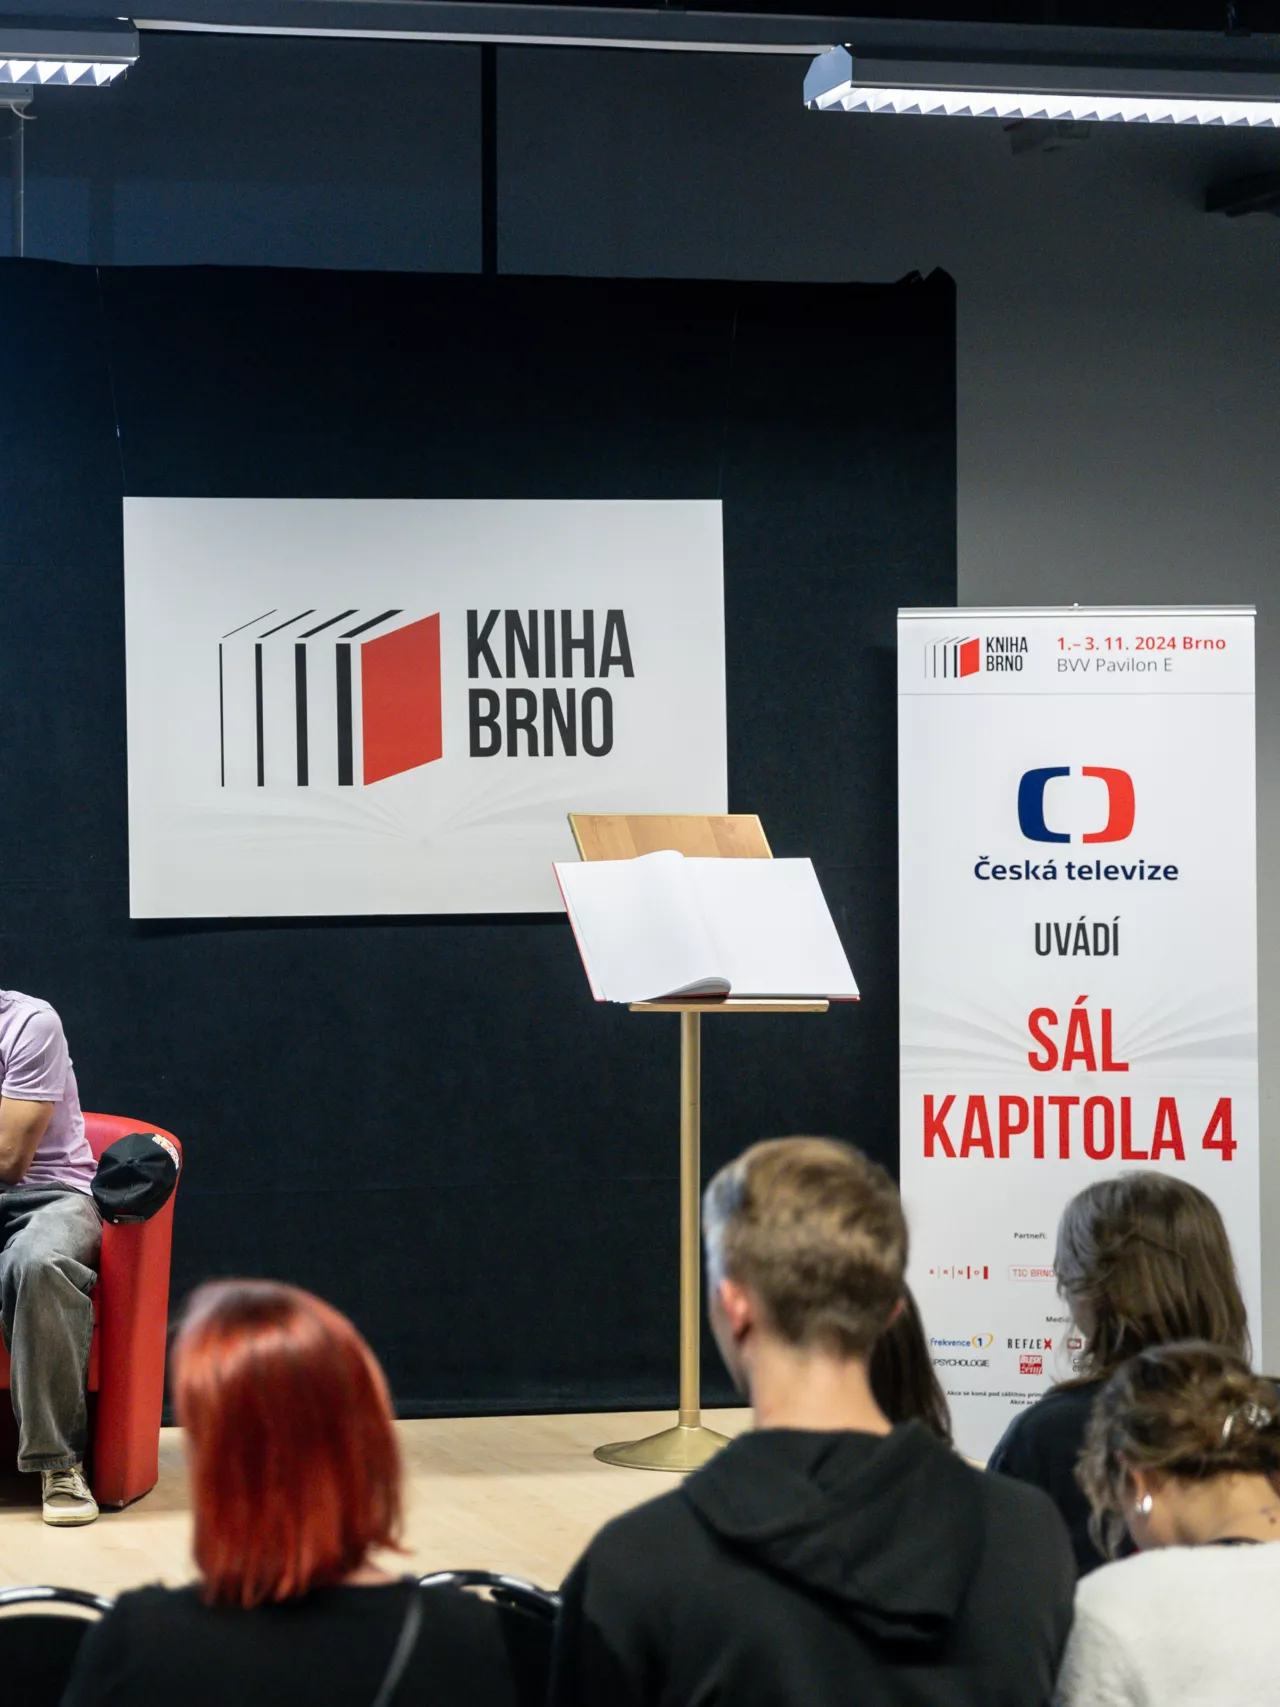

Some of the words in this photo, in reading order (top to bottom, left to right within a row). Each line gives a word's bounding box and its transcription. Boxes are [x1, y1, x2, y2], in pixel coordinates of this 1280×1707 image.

[466, 609, 635, 679] KNIHA
[986, 636, 1029, 653] KNIHA
[1105, 636, 1129, 651] 11.
[1135, 636, 1177, 651] 2024
[1182, 636, 1226, 651] Brno
[986, 655, 1024, 672] BRNO
[1057, 658, 1091, 673] BVV
[1096, 657, 1158, 673] Pavilon
[1163, 657, 1173, 673] E
[468, 687, 614, 758] BRNO
[973, 855, 1058, 881] Česká
[1064, 859, 1179, 881] televize
[1034, 916, 1121, 957] UVÁDÍ
[1027, 995, 1130, 1073] SÁL
[923, 1094, 1186, 1162] KAPITOLA
[1202, 1097, 1238, 1162] 4
[1007, 1337, 1052, 1351] REFLEX
